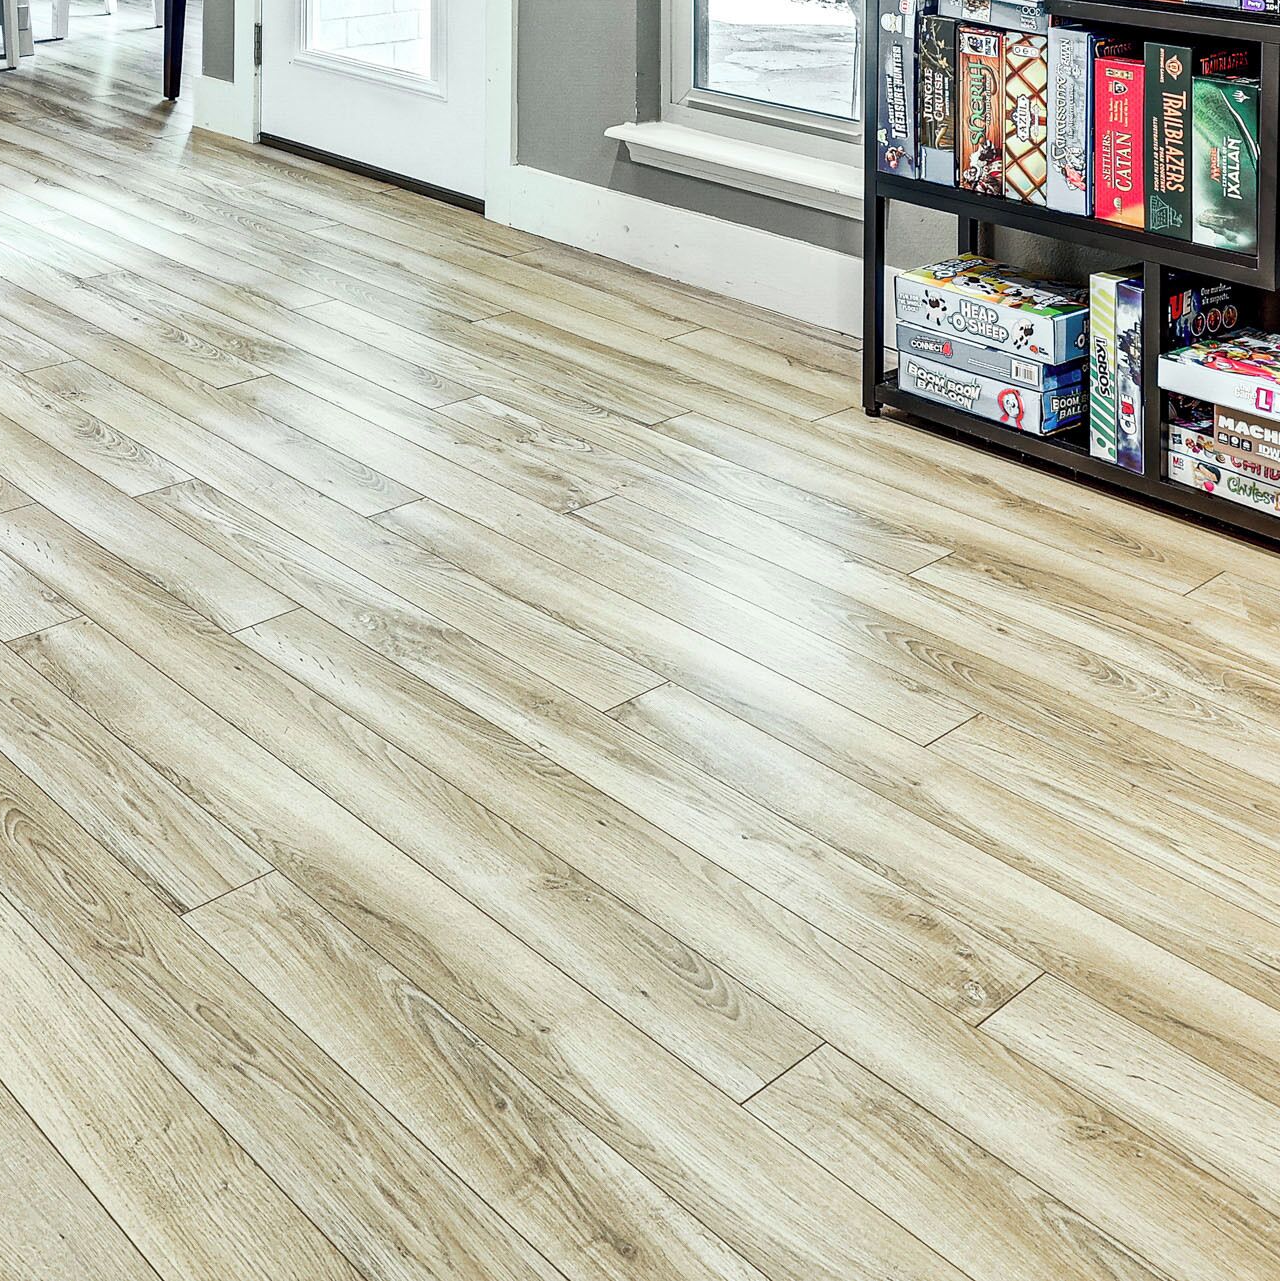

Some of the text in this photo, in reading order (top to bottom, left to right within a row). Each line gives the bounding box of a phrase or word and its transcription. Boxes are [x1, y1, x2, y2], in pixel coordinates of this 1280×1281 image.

[923, 67, 933, 122] JUNGLE
[933, 72, 944, 121] CRUISE
[1018, 100, 1028, 135] AZUL
[1102, 136, 1111, 180] SETTLERS
[1115, 131, 1132, 192] CATAN
[1162, 91, 1186, 193] TRAILBLAZERS
[1227, 136, 1243, 200] IXALAN
[960, 299, 998, 324] HEAP
[908, 361, 981, 400] BOOM BOOM
[1095, 335, 1109, 397] SORRY!
[917, 378, 972, 409] BALLOON
[1121, 394, 1137, 435] CLUE
[1227, 476, 1271, 505] Chutes
